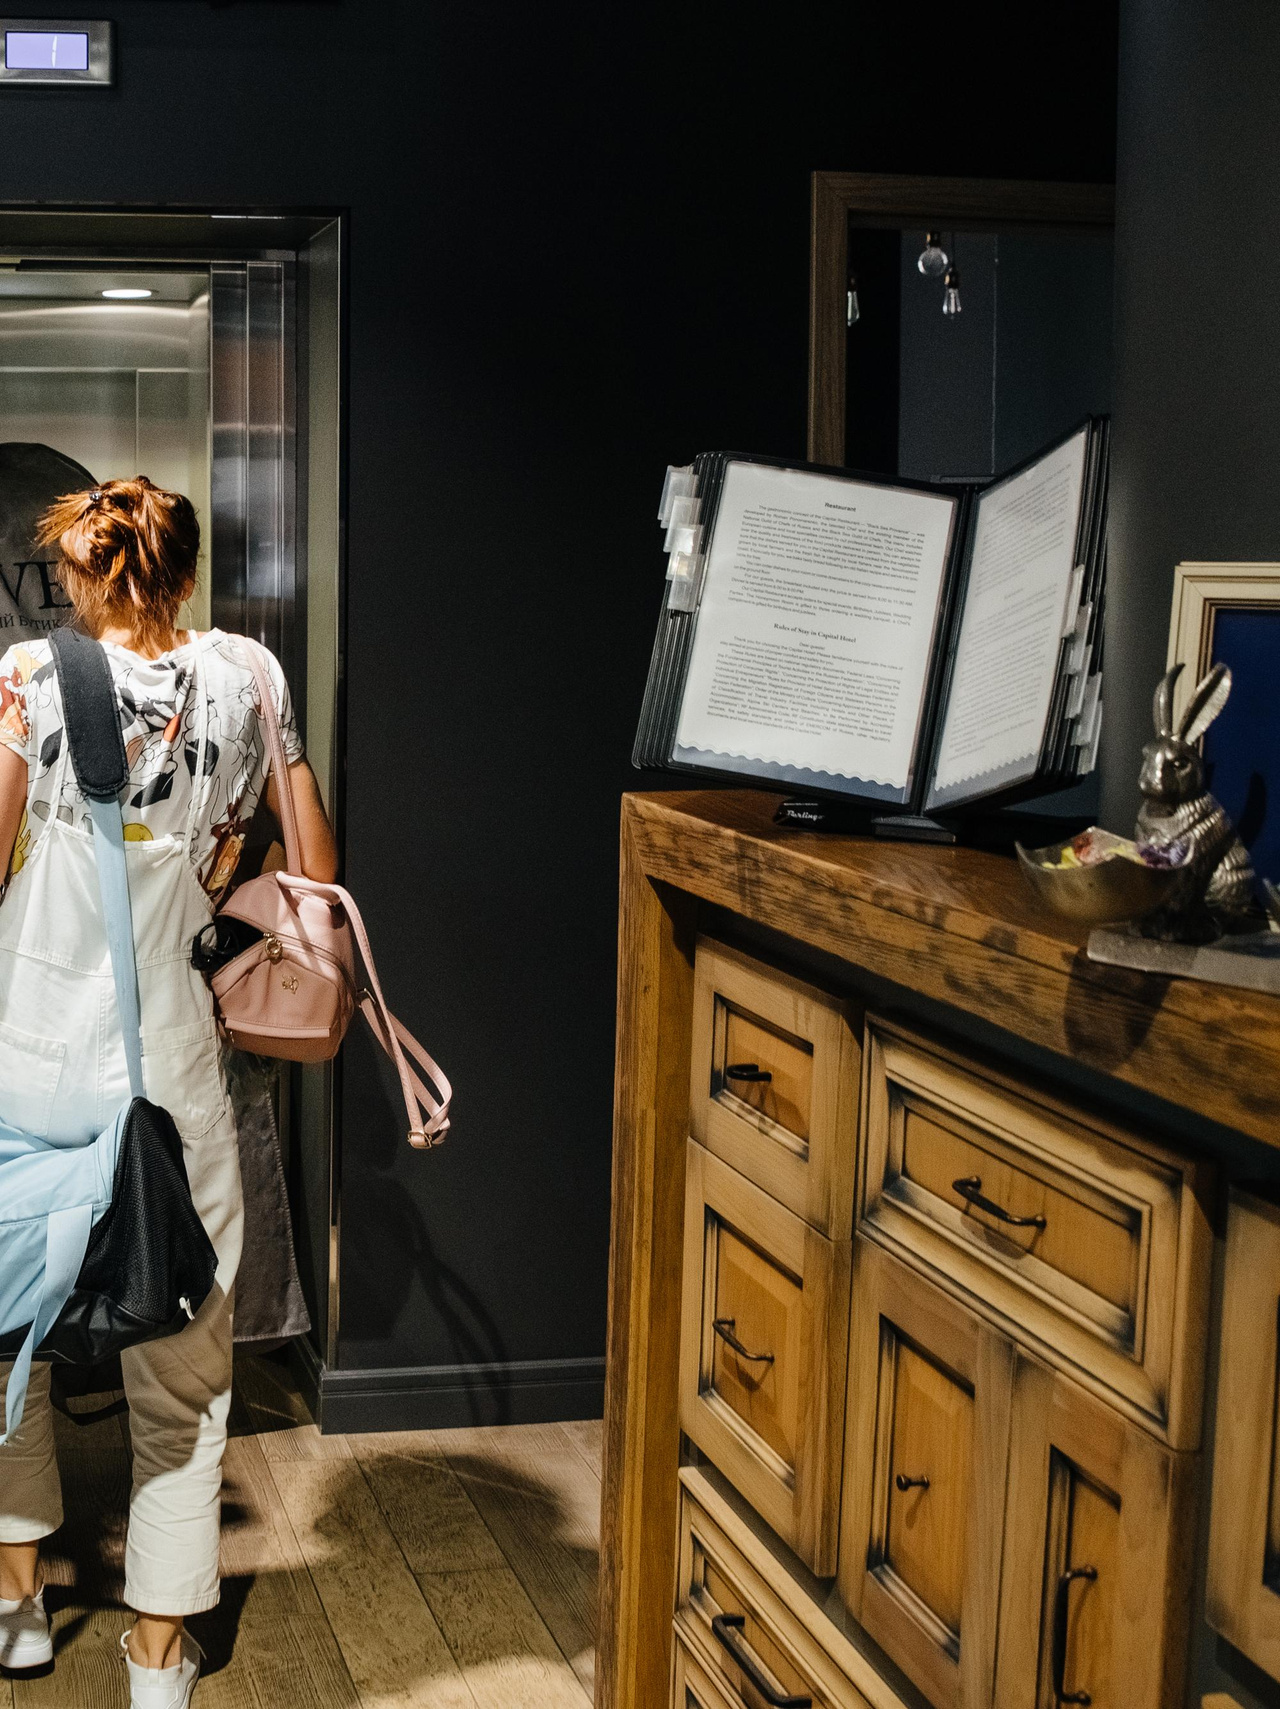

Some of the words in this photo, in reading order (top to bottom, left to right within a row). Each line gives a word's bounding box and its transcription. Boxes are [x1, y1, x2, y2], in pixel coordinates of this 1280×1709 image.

[824, 502, 857, 512] Restaurant
[773, 623, 790, 631] Rules
[798, 628, 809, 636] Stay
[818, 631, 839, 640] Capital
[840, 635, 856, 643] Hotel
